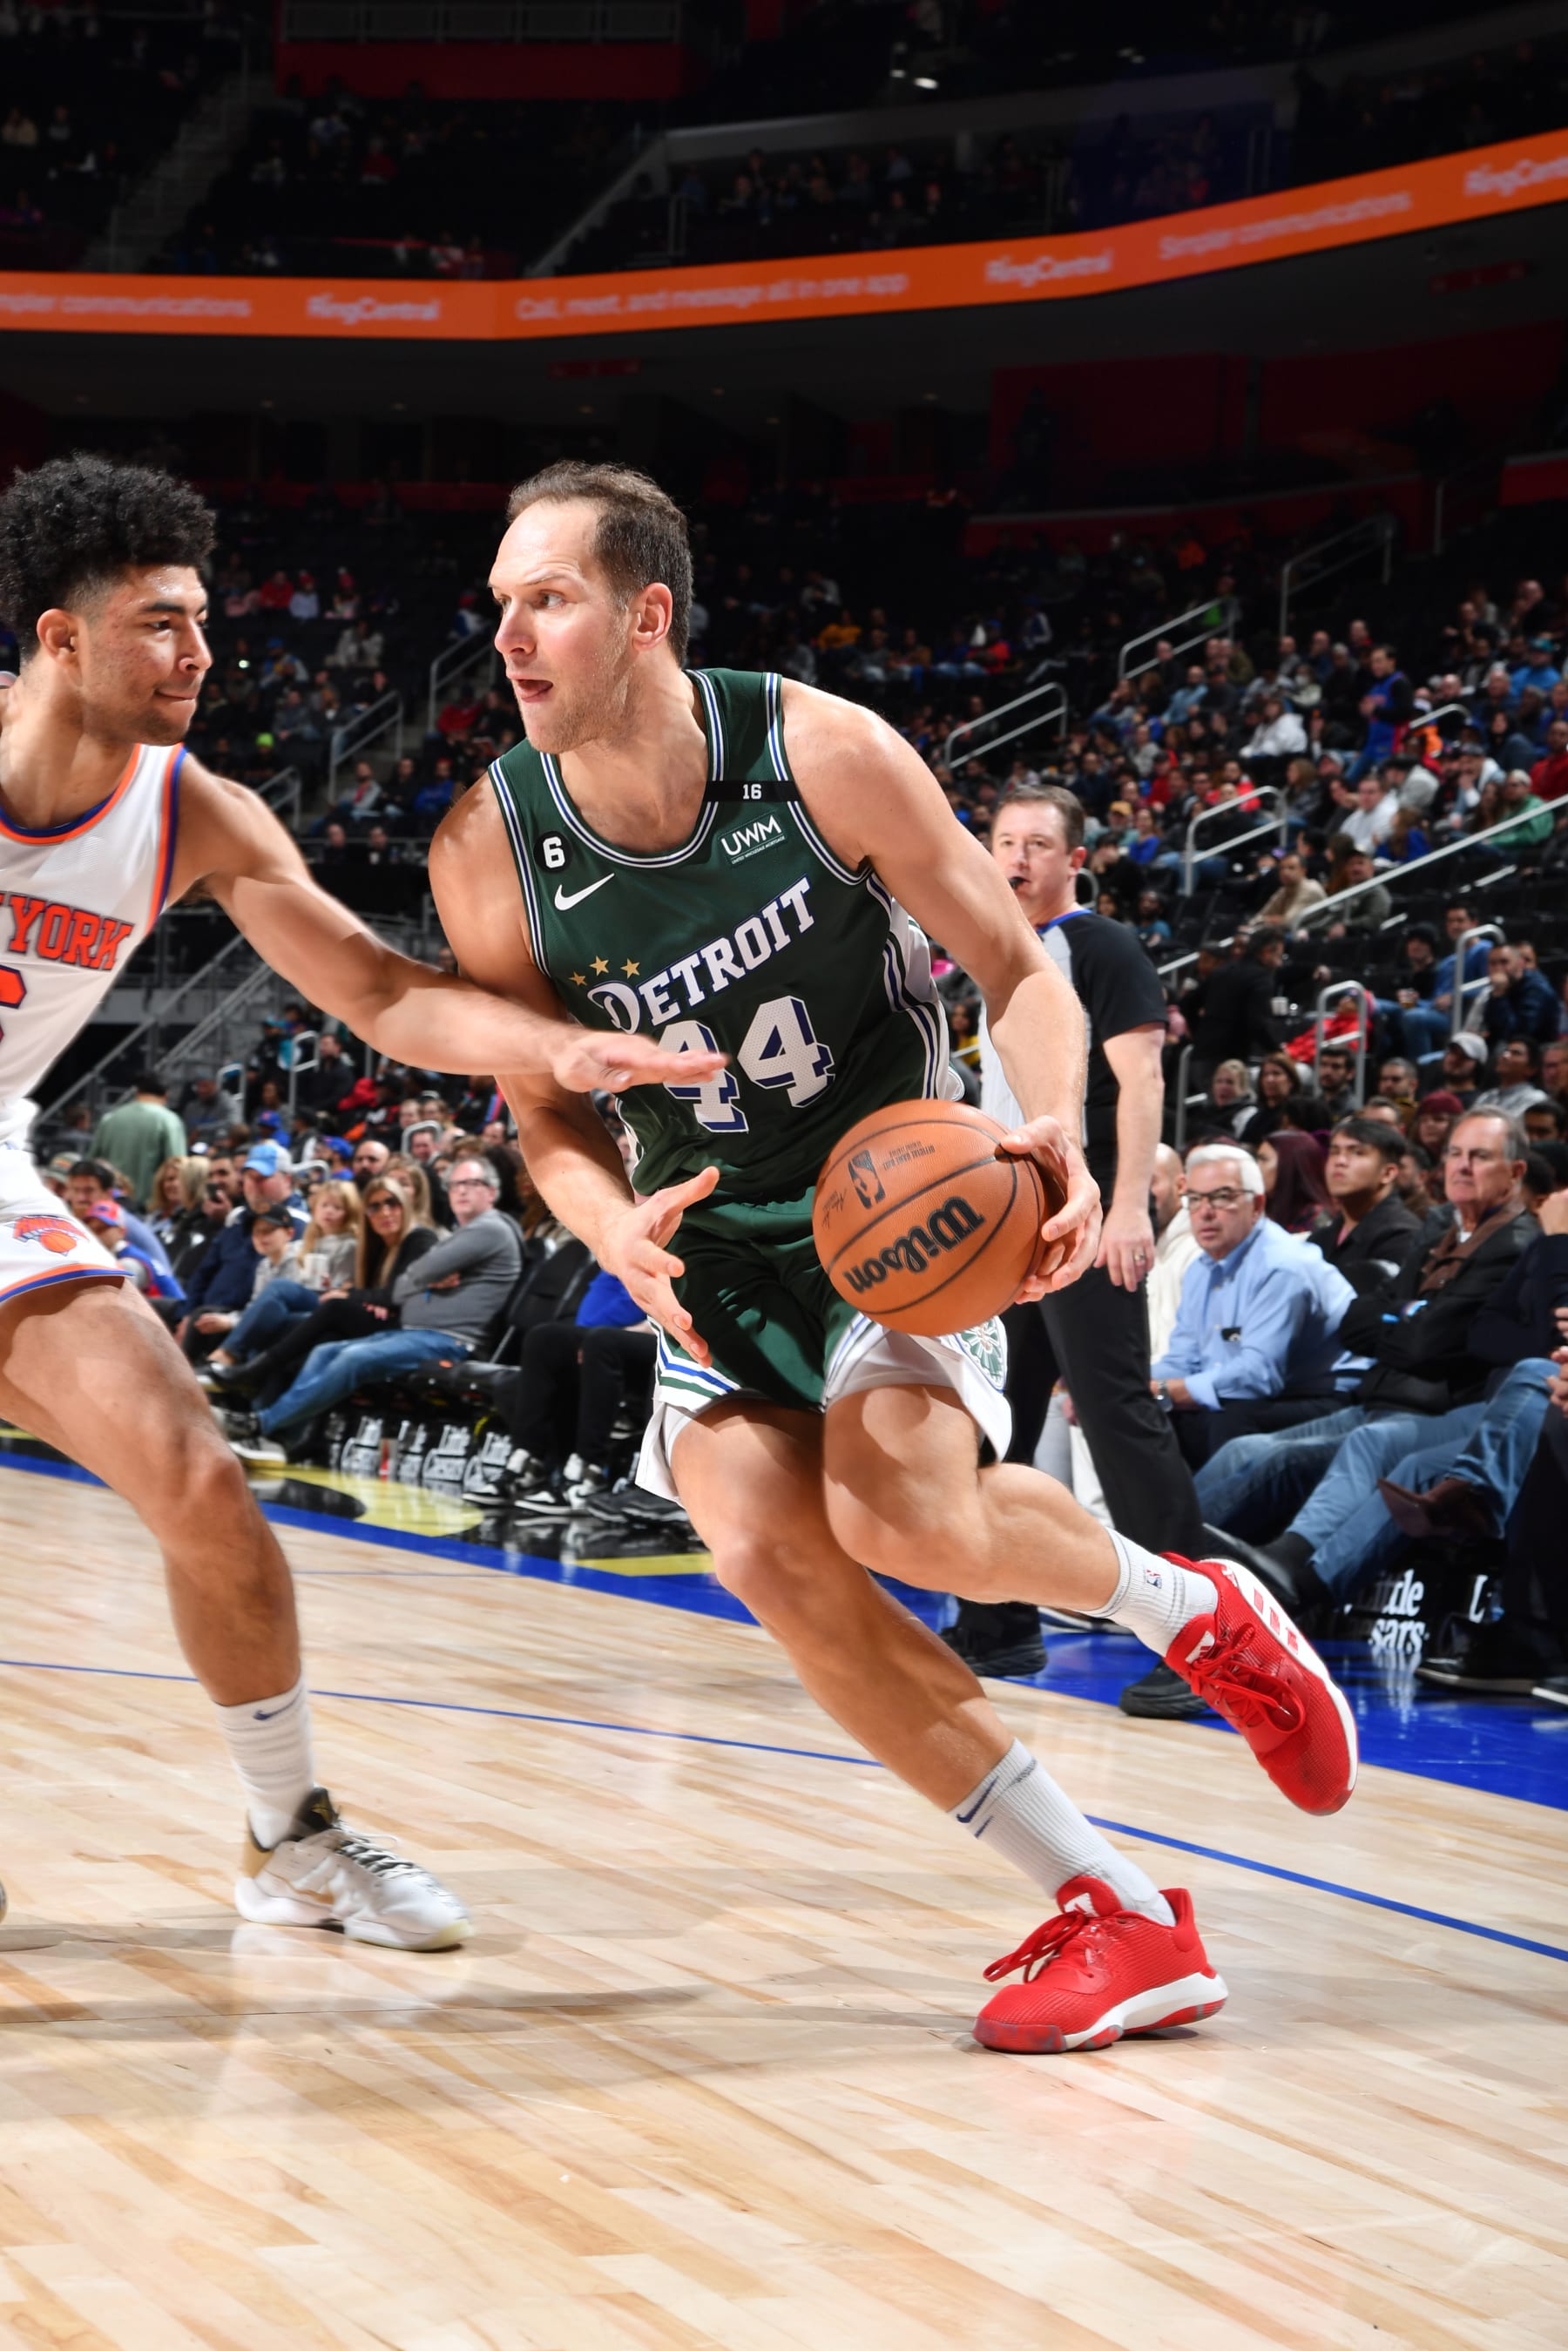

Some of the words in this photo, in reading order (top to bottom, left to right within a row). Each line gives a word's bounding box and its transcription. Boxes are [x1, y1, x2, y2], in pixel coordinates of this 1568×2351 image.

[985, 250, 1113, 287] RingCentral
[0, 294, 56, 314] mpler
[307, 294, 440, 325] RingCentral
[743, 784, 762, 800] 16
[543, 836, 565, 868] 6
[720, 814, 782, 855] UWM
[8, 891, 135, 971] YORK
[587, 875, 815, 1035] DETROIT
[656, 995, 836, 1134] 44
[911, 1144, 936, 1159] OFFICIAL
[842, 1196, 986, 1294] Wilson
